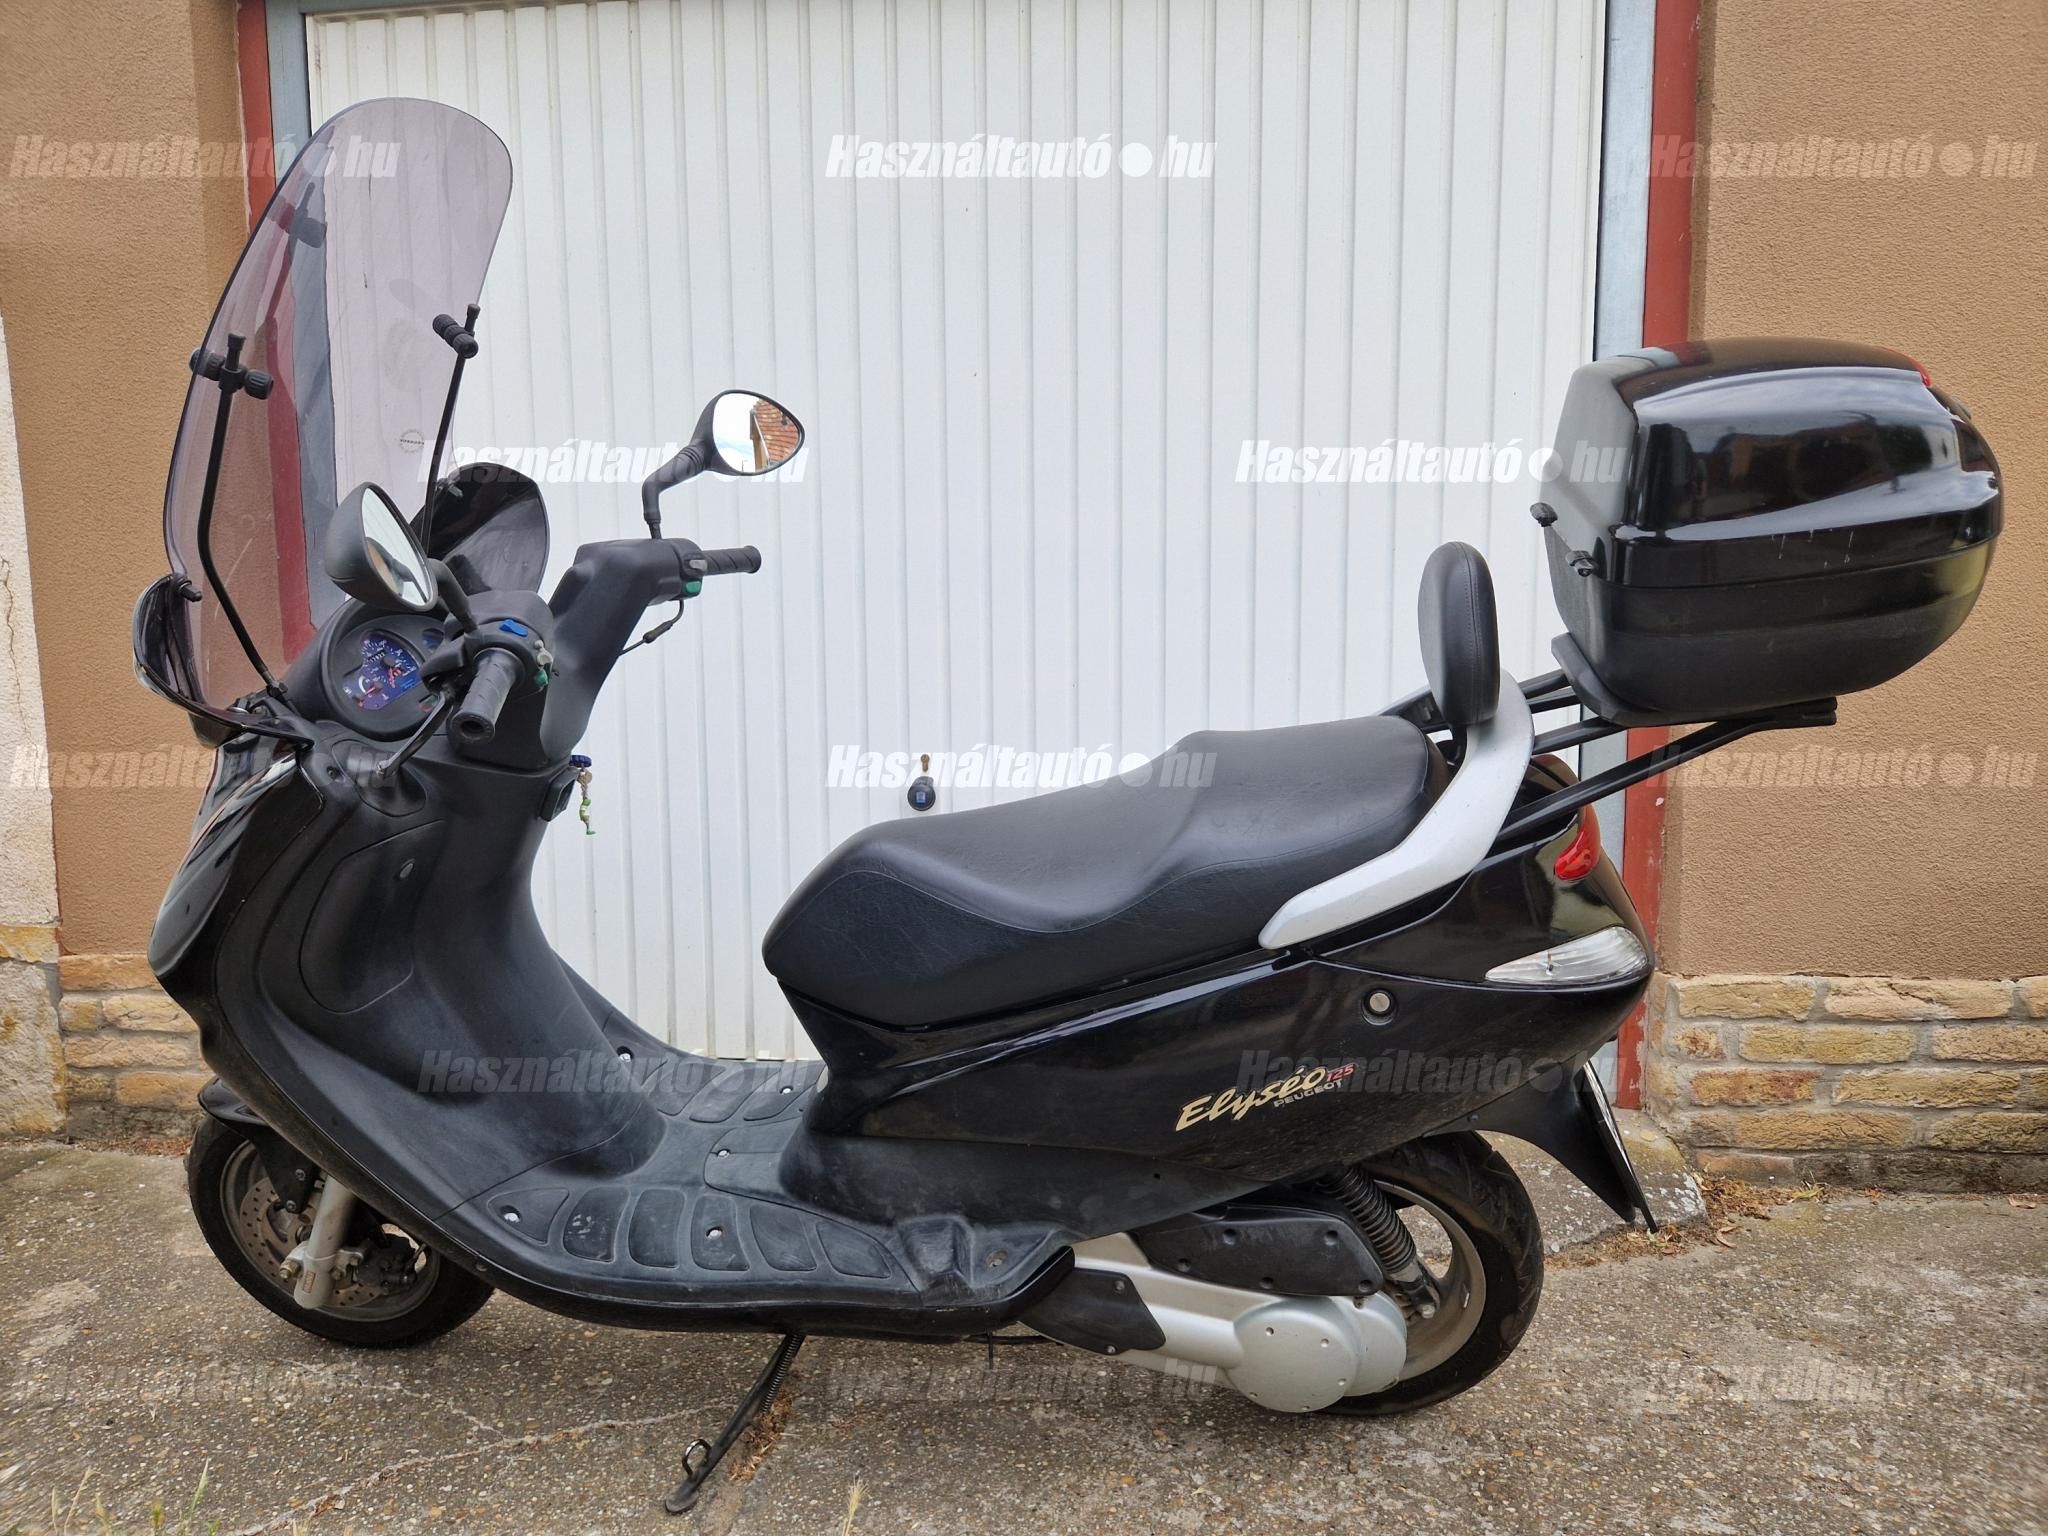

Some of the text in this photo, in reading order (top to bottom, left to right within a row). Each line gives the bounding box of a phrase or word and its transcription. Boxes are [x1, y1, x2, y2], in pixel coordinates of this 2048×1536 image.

[1176, 1064, 1355, 1131] Elyséo 125
[1274, 1079, 1343, 1108] PEUGEOT
